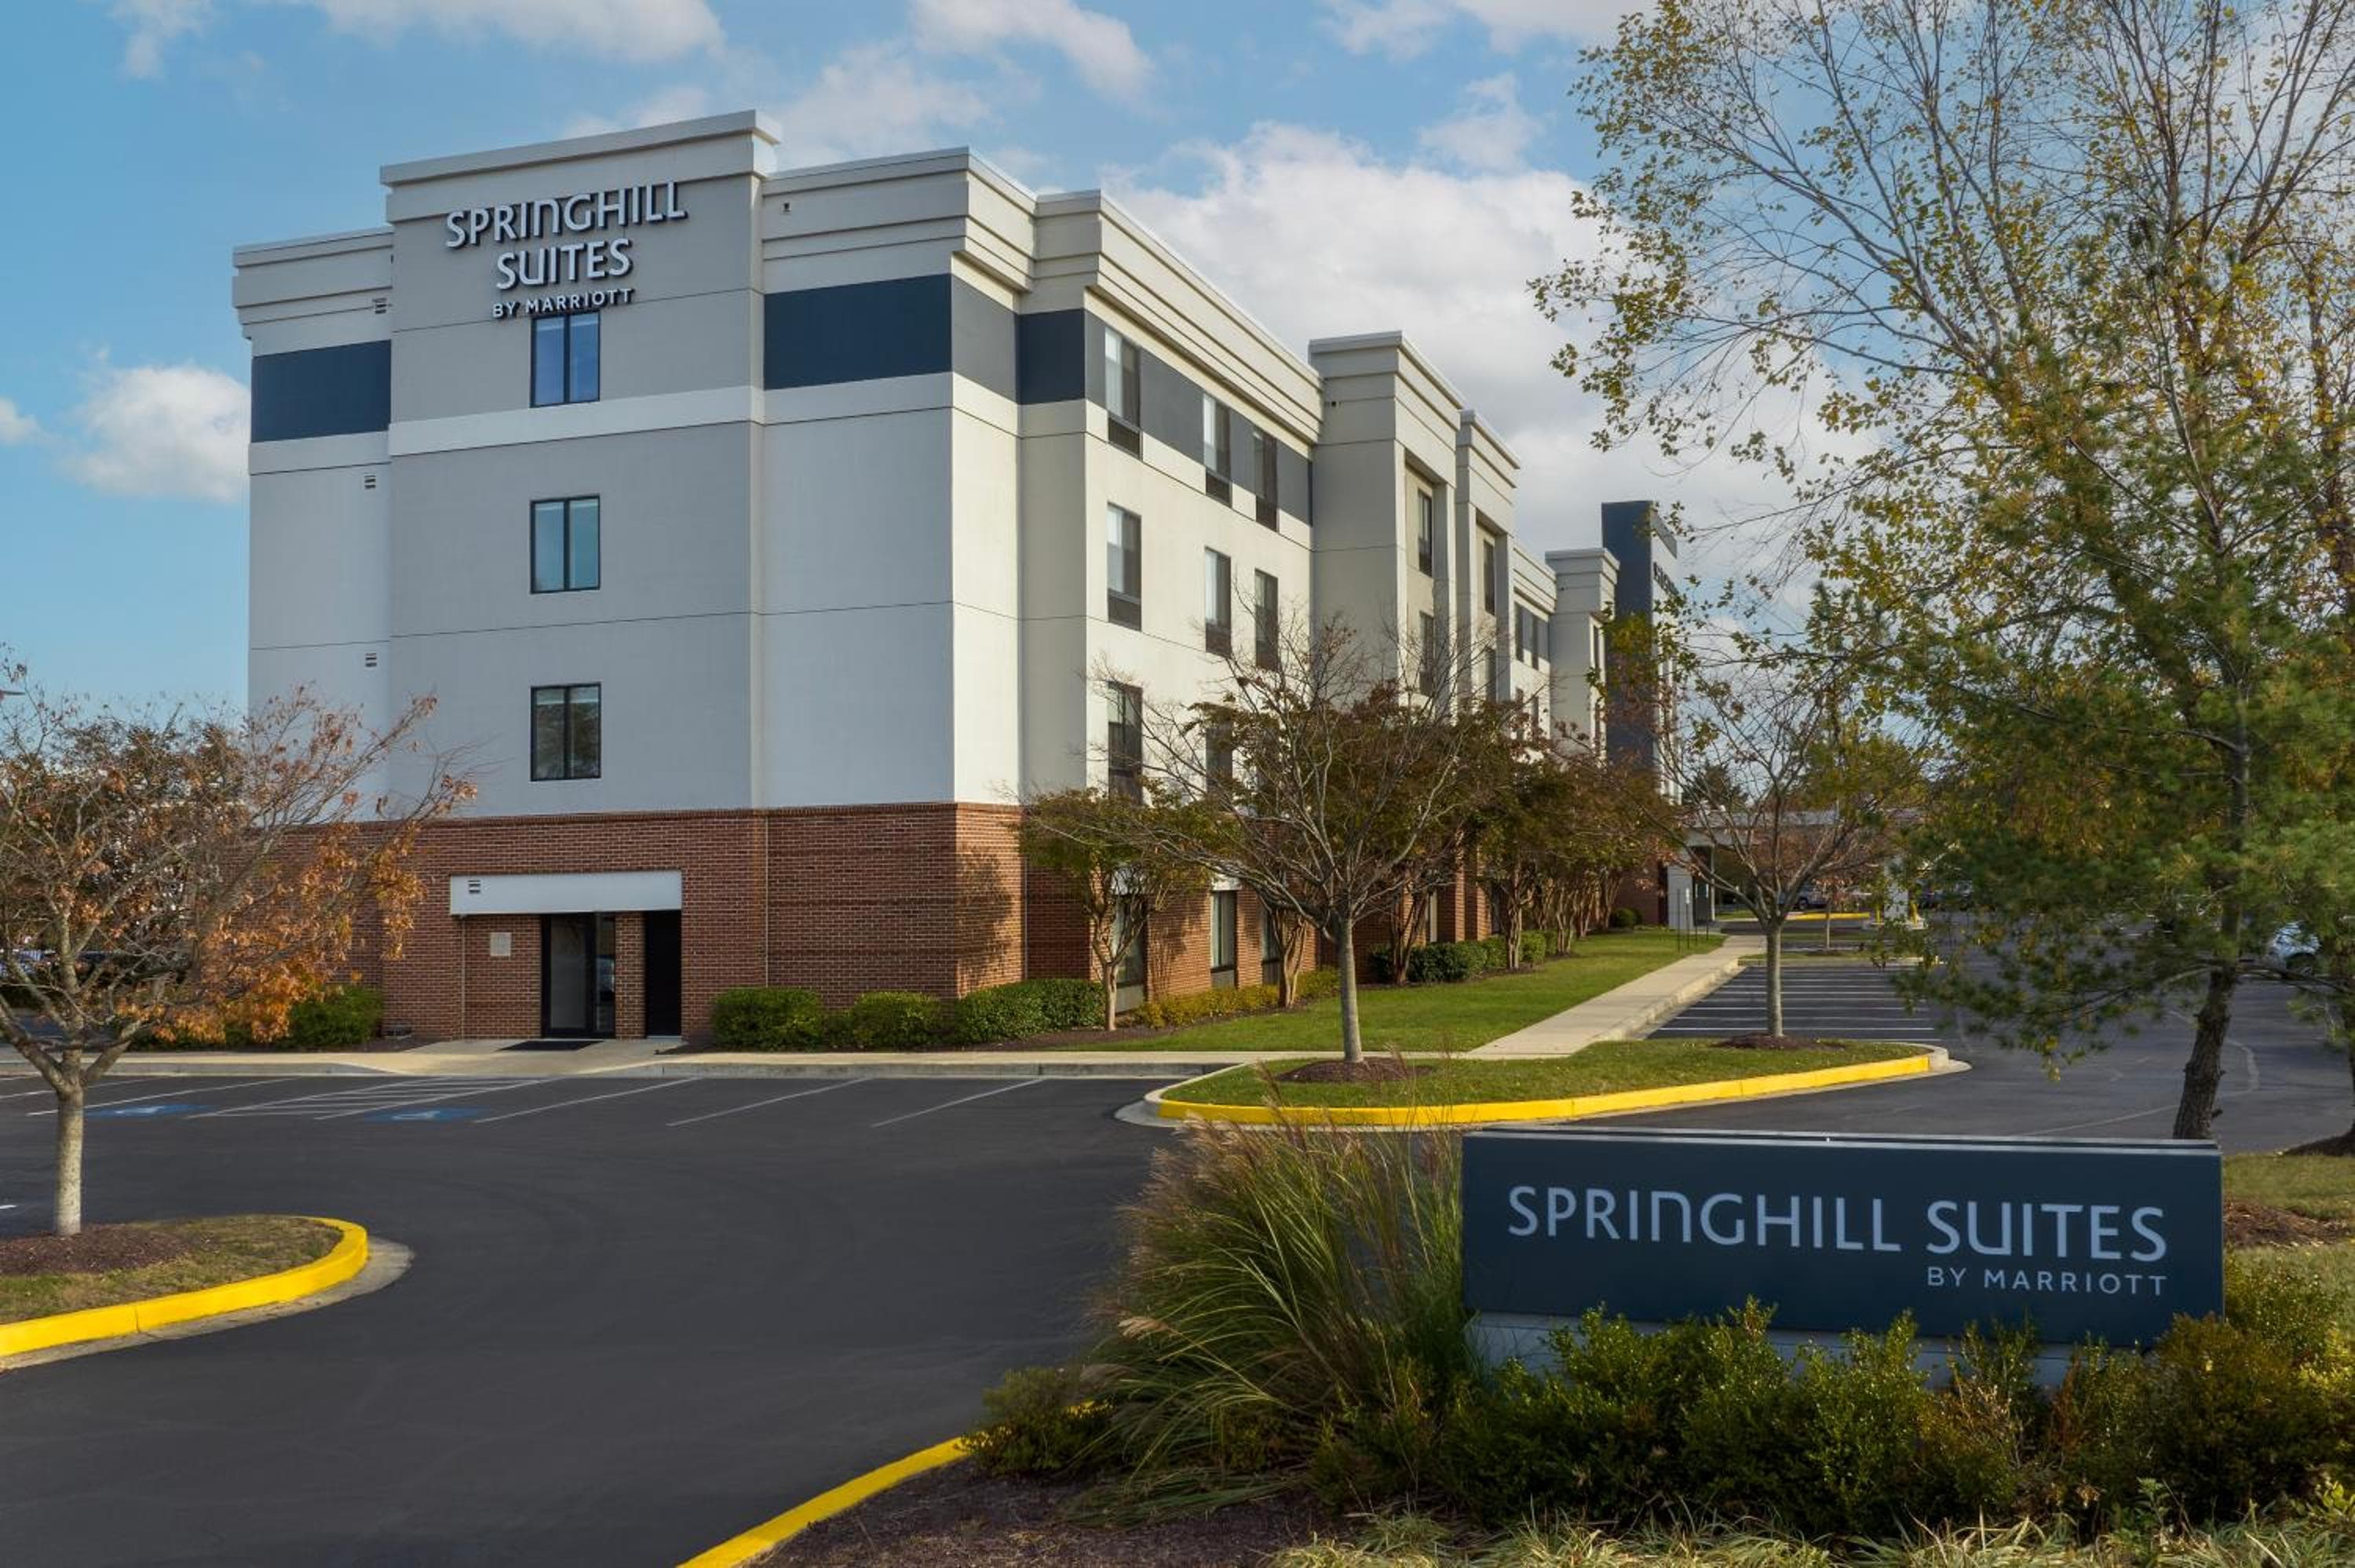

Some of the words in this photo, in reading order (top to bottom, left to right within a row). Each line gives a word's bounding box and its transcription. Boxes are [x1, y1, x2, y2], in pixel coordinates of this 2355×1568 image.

[445, 181, 687, 248] SPRINGHILL
[495, 238, 633, 290] SUITES
[492, 301, 520, 319] BY
[525, 287, 634, 314] MARRIOTT
[1508, 1186, 1901, 1252] SPRINGHILL
[1926, 1200, 2167, 1261] SUITES
[1928, 1266, 1966, 1287] BY
[1984, 1269, 2167, 1296] MARRIOTT
